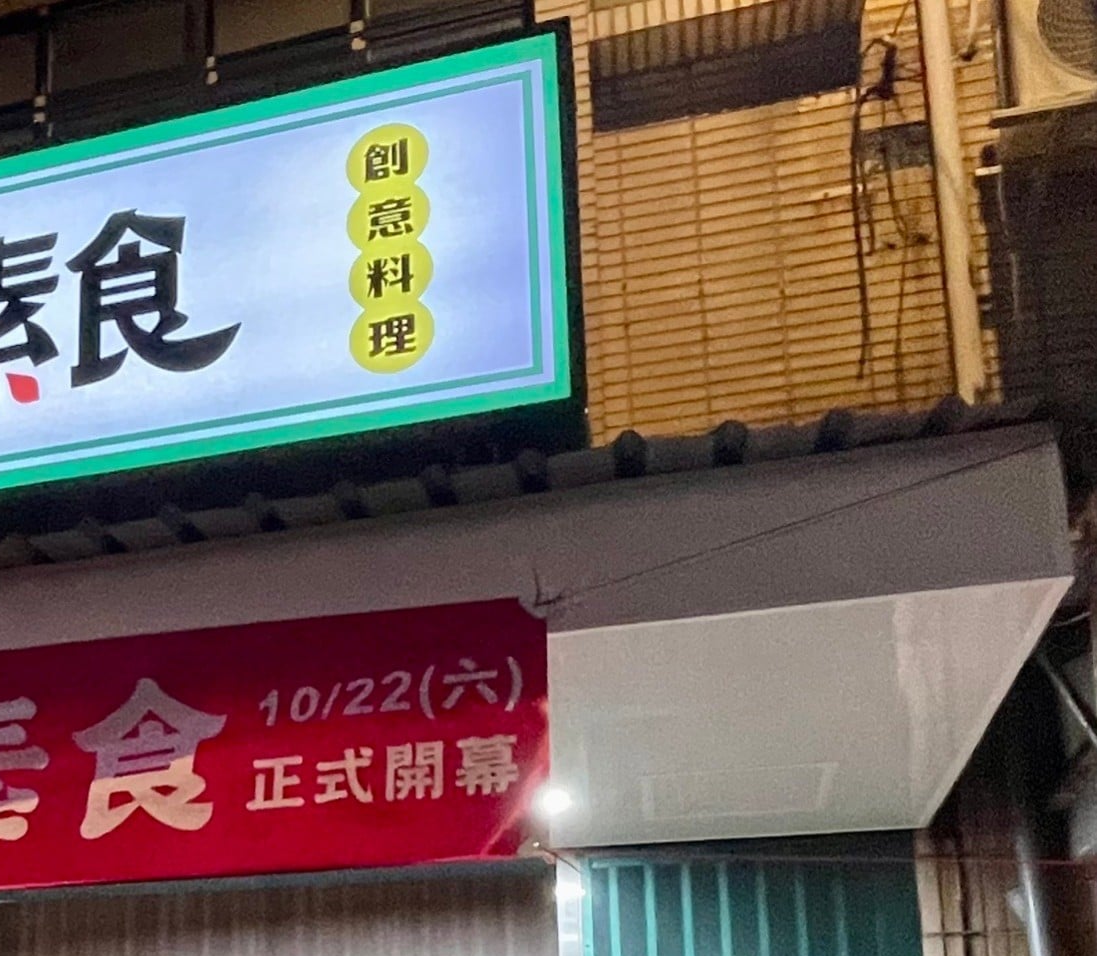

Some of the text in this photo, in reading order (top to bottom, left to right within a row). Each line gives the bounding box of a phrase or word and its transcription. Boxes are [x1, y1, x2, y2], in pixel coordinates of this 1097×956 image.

[364, 137, 417, 358] 創意料理
[259, 655, 524, 727] 10/22(六)
[246, 733, 521, 811] 正式開幕
